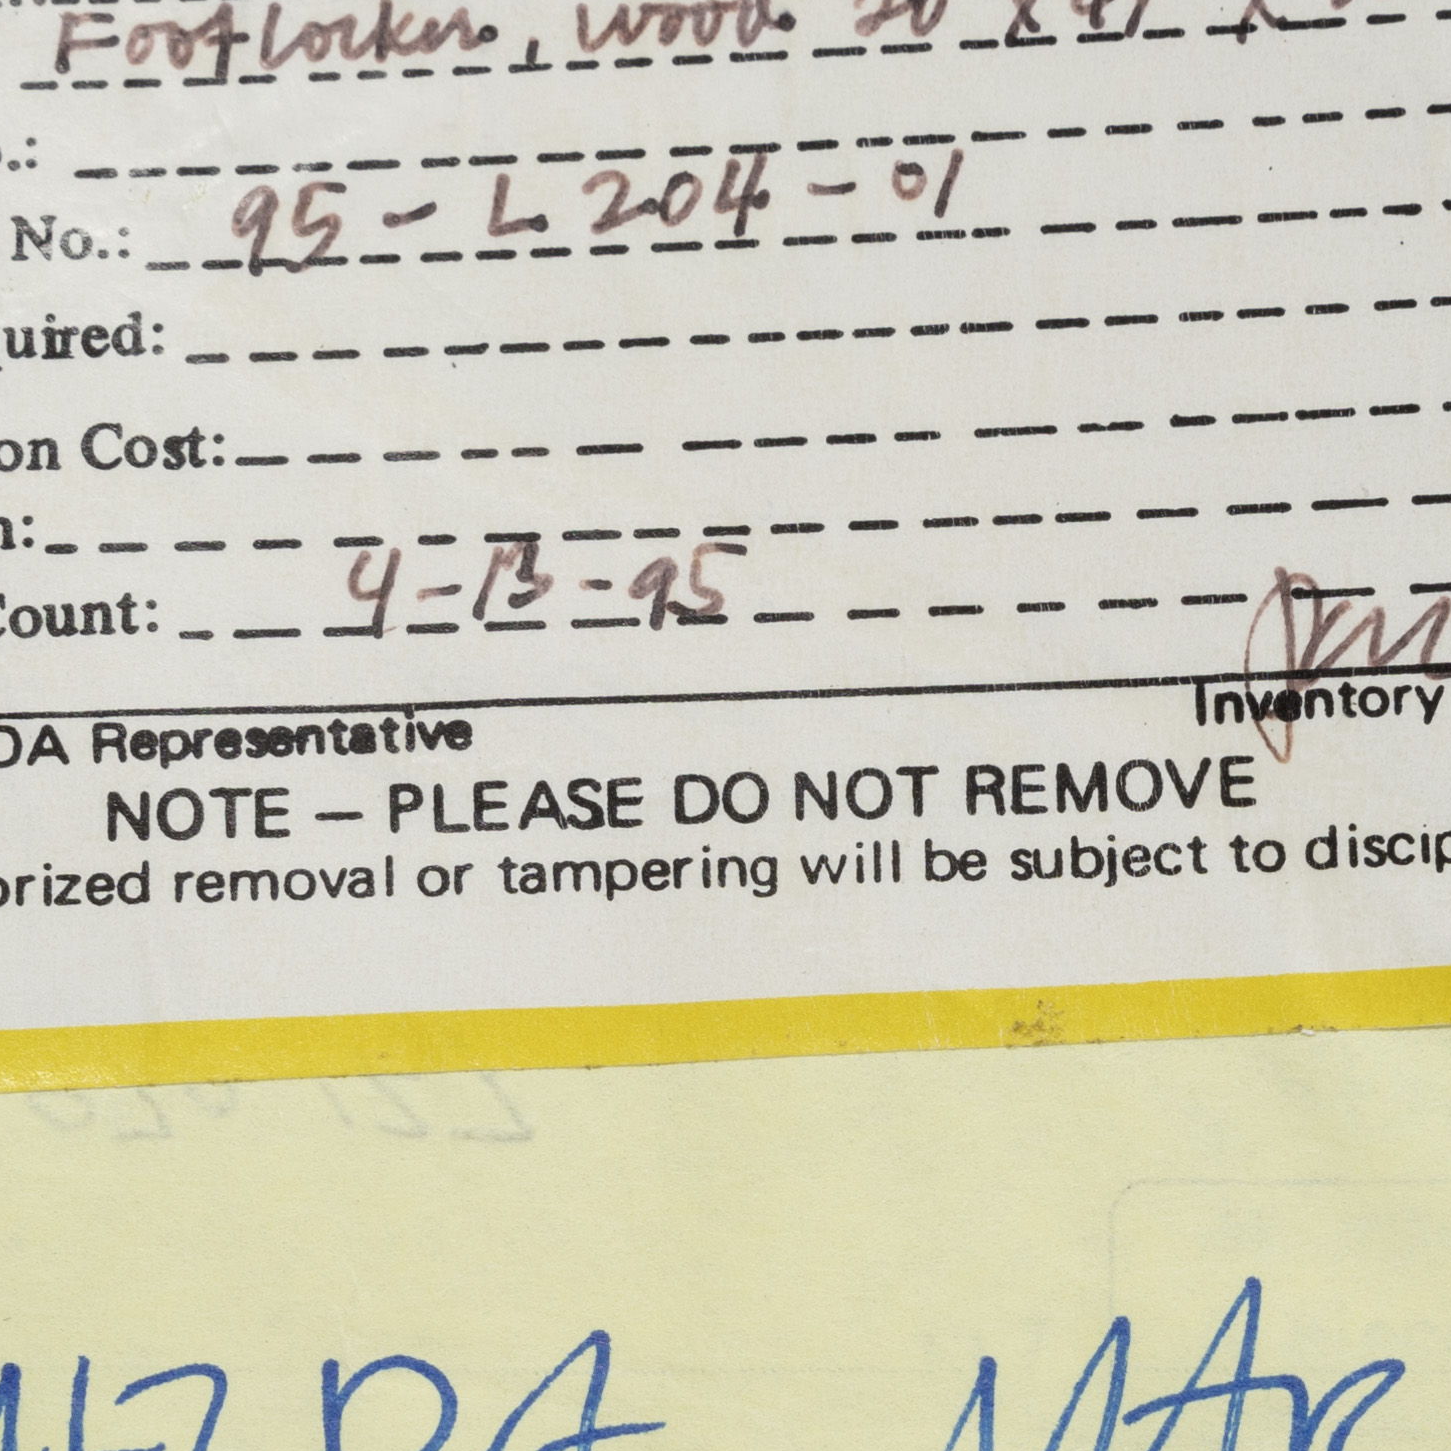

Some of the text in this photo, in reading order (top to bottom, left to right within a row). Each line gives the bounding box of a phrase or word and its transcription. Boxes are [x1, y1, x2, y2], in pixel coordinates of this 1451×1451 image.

[11, 216, 129, 261] No.:
[81, 423, 224, 470] Cost:
[1190, 677, 1443, 728] Inventory
[92, 716, 472, 767] Representative
[107, 787, 290, 841] NOTE
[390, 777, 643, 833] PLEASE
[674, 772, 769, 824] DO
[795, 766, 939, 821] NOT
[966, 756, 1256, 816] REMOVE
[175, 855, 393, 903] removal
[417, 863, 473, 897] or
[498, 846, 777, 901] tampering
[800, 840, 900, 884] will
[925, 839, 987, 882] be
[1011, 835, 1207, 887] subject
[1229, 835, 1286, 873] to
